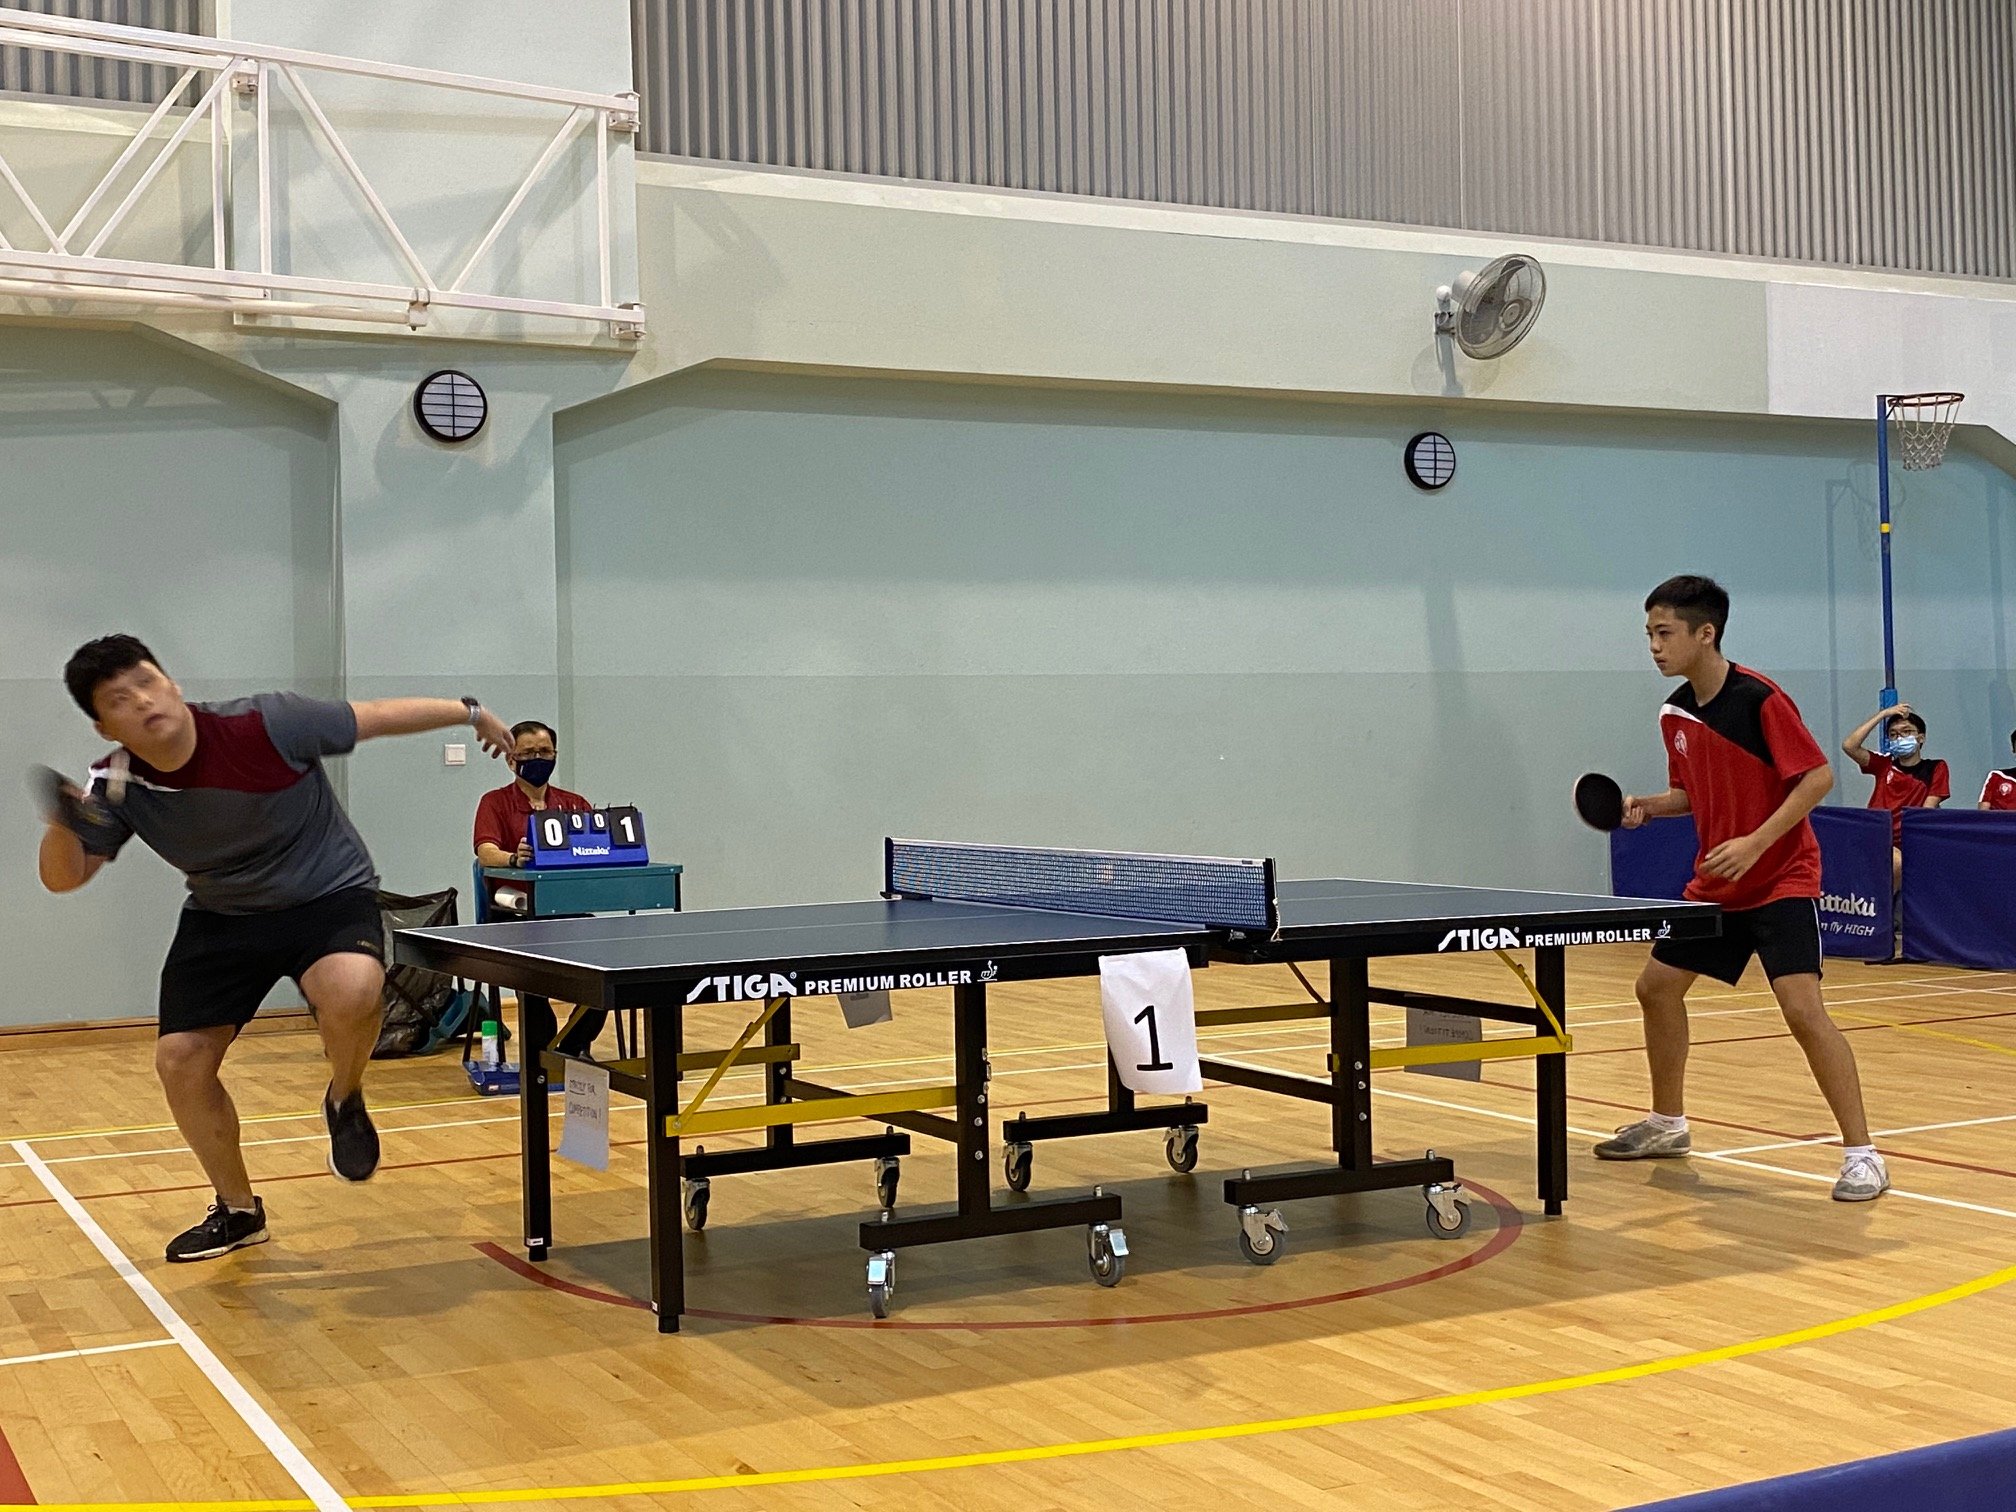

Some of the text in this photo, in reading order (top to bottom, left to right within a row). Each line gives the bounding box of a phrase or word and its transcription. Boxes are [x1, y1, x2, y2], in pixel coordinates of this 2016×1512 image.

[544, 818, 563, 846] 0
[571, 813, 583, 829] 0
[593, 813, 605, 828] 0
[620, 816, 636, 843] 1
[1820, 891, 1876, 917] ittaku
[1525, 931, 1593, 947] PREMIUM
[1596, 928, 1651, 943] ROLLER
[1829, 921, 1843, 934] fly
[1843, 923, 1875, 936] HIGH
[804, 975, 895, 994] PREMIUM
[899, 970, 972, 988] ROLLER
[1134, 1005, 1173, 1071] 1
